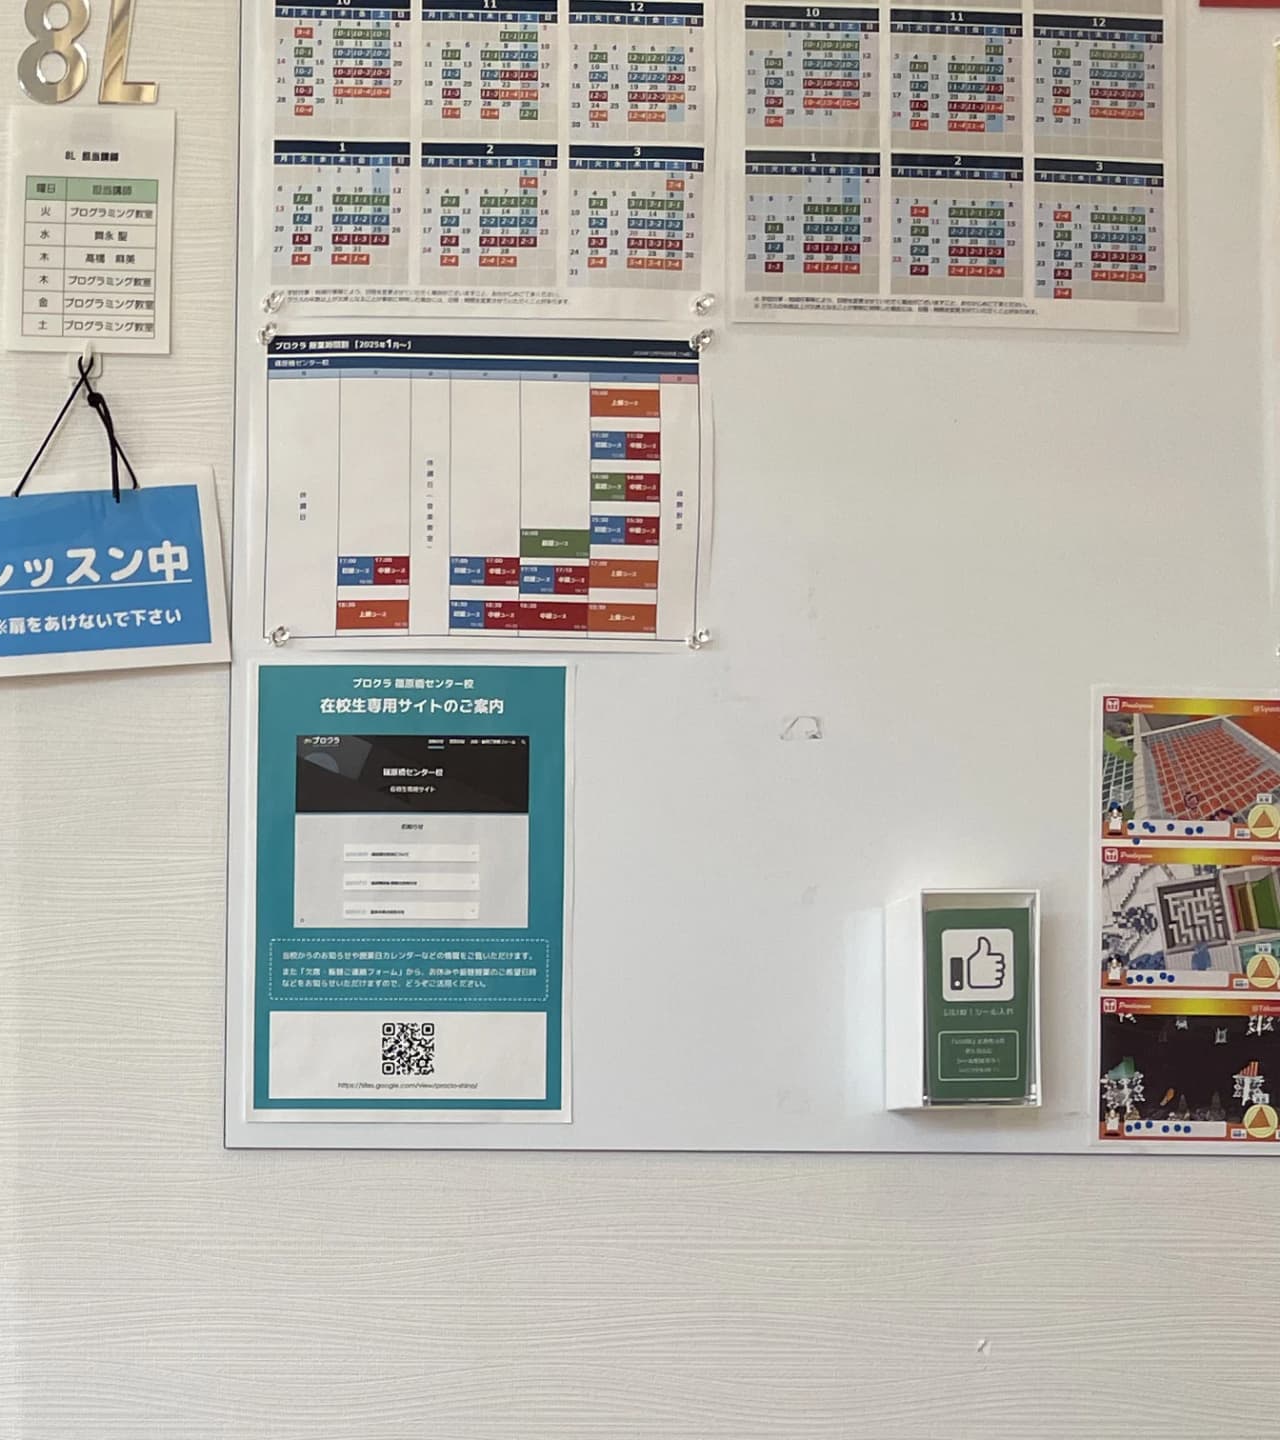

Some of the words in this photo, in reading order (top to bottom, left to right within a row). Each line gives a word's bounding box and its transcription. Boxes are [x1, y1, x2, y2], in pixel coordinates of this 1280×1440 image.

[806, 8, 820, 17] 10
[353, 678, 392, 689] プロクラ
[320, 698, 504, 715] 在校生専用サイトのご案内
